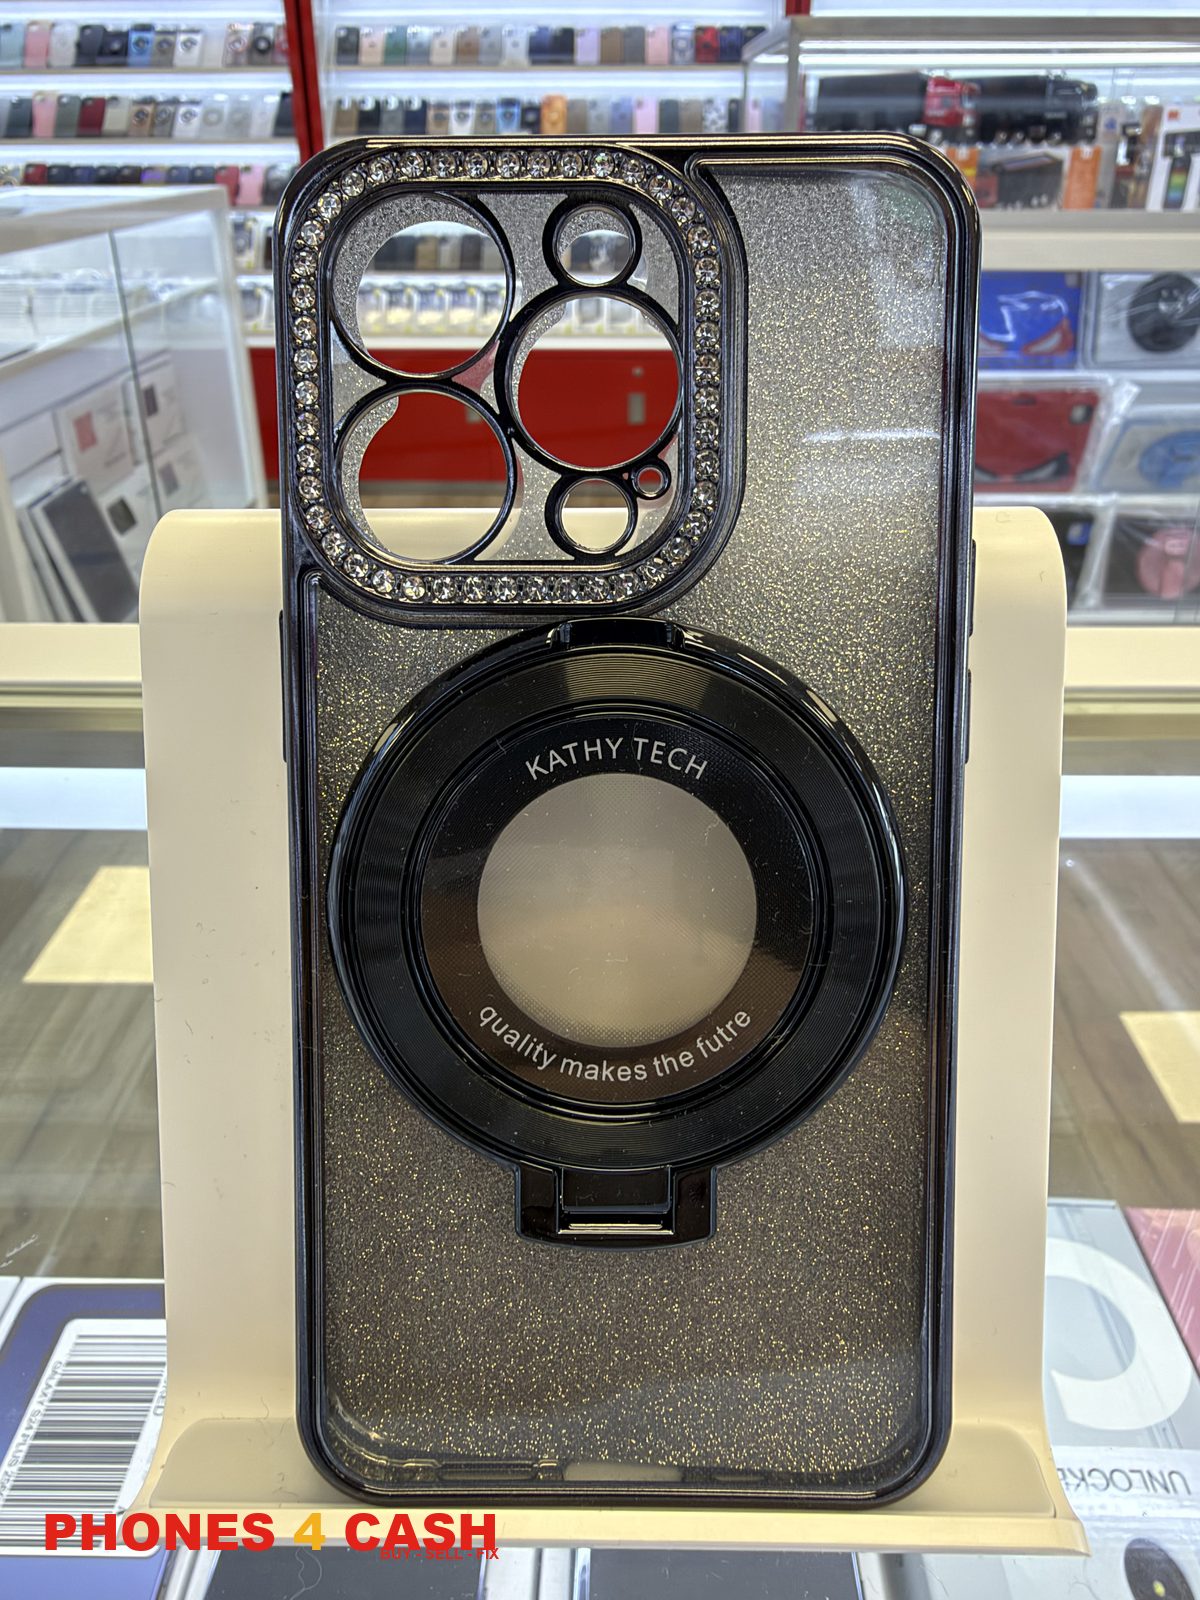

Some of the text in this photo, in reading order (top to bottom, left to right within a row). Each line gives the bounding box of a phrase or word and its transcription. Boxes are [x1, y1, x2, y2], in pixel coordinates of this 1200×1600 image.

[525, 737, 708, 781] KATHY TECH
[479, 1005, 751, 1082] quality makes the futre
